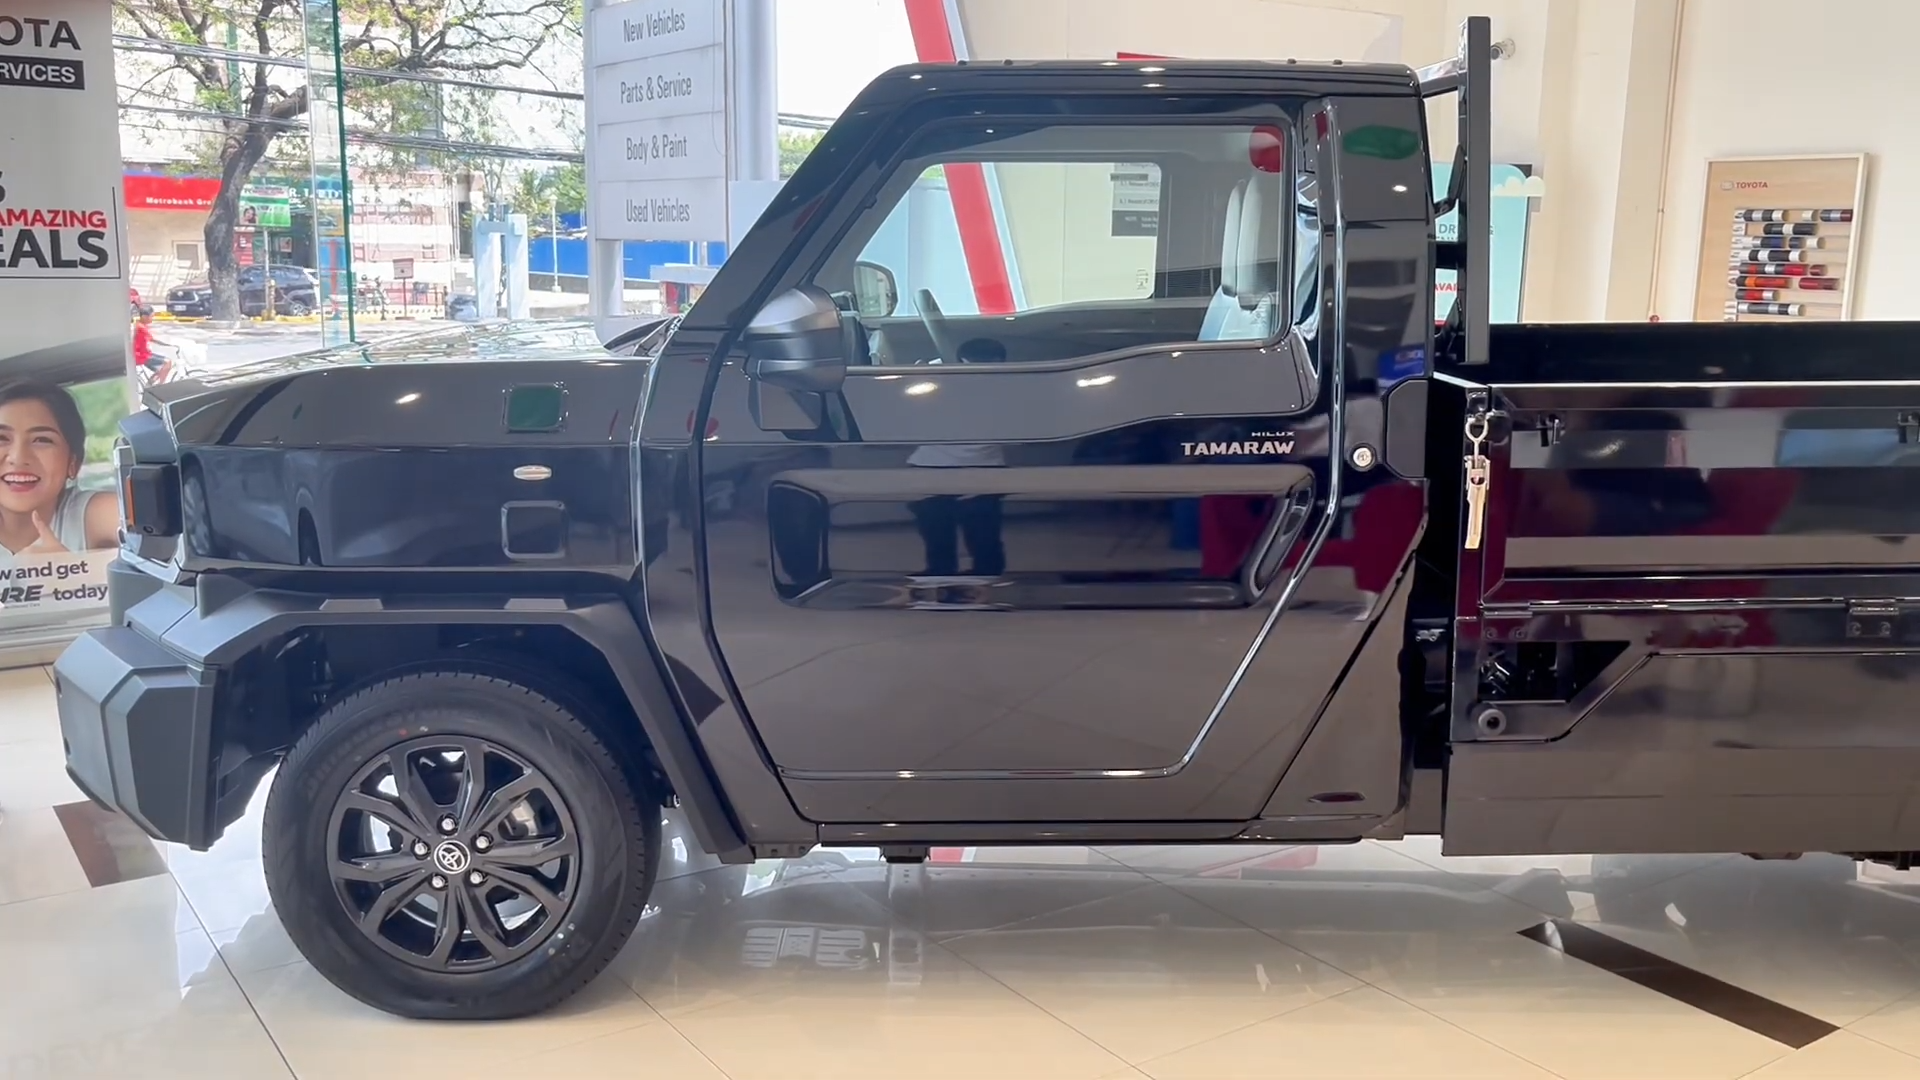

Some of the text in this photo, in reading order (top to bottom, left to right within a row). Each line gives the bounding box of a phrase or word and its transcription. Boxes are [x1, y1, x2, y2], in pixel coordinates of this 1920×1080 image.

[623, 7, 686, 43] New Vehicles
[620, 71, 692, 104] Parts & Service
[626, 132, 687, 165] Body & Paint
[1736, 181, 1768, 189] TOYOTA
[626, 197, 690, 222] Used Vehicles
[0, 228, 109, 269] ALS
[1180, 440, 1295, 456] TAMARAW
[16, 561, 53, 579] and
[56, 560, 89, 580] get
[53, 583, 108, 601] today
